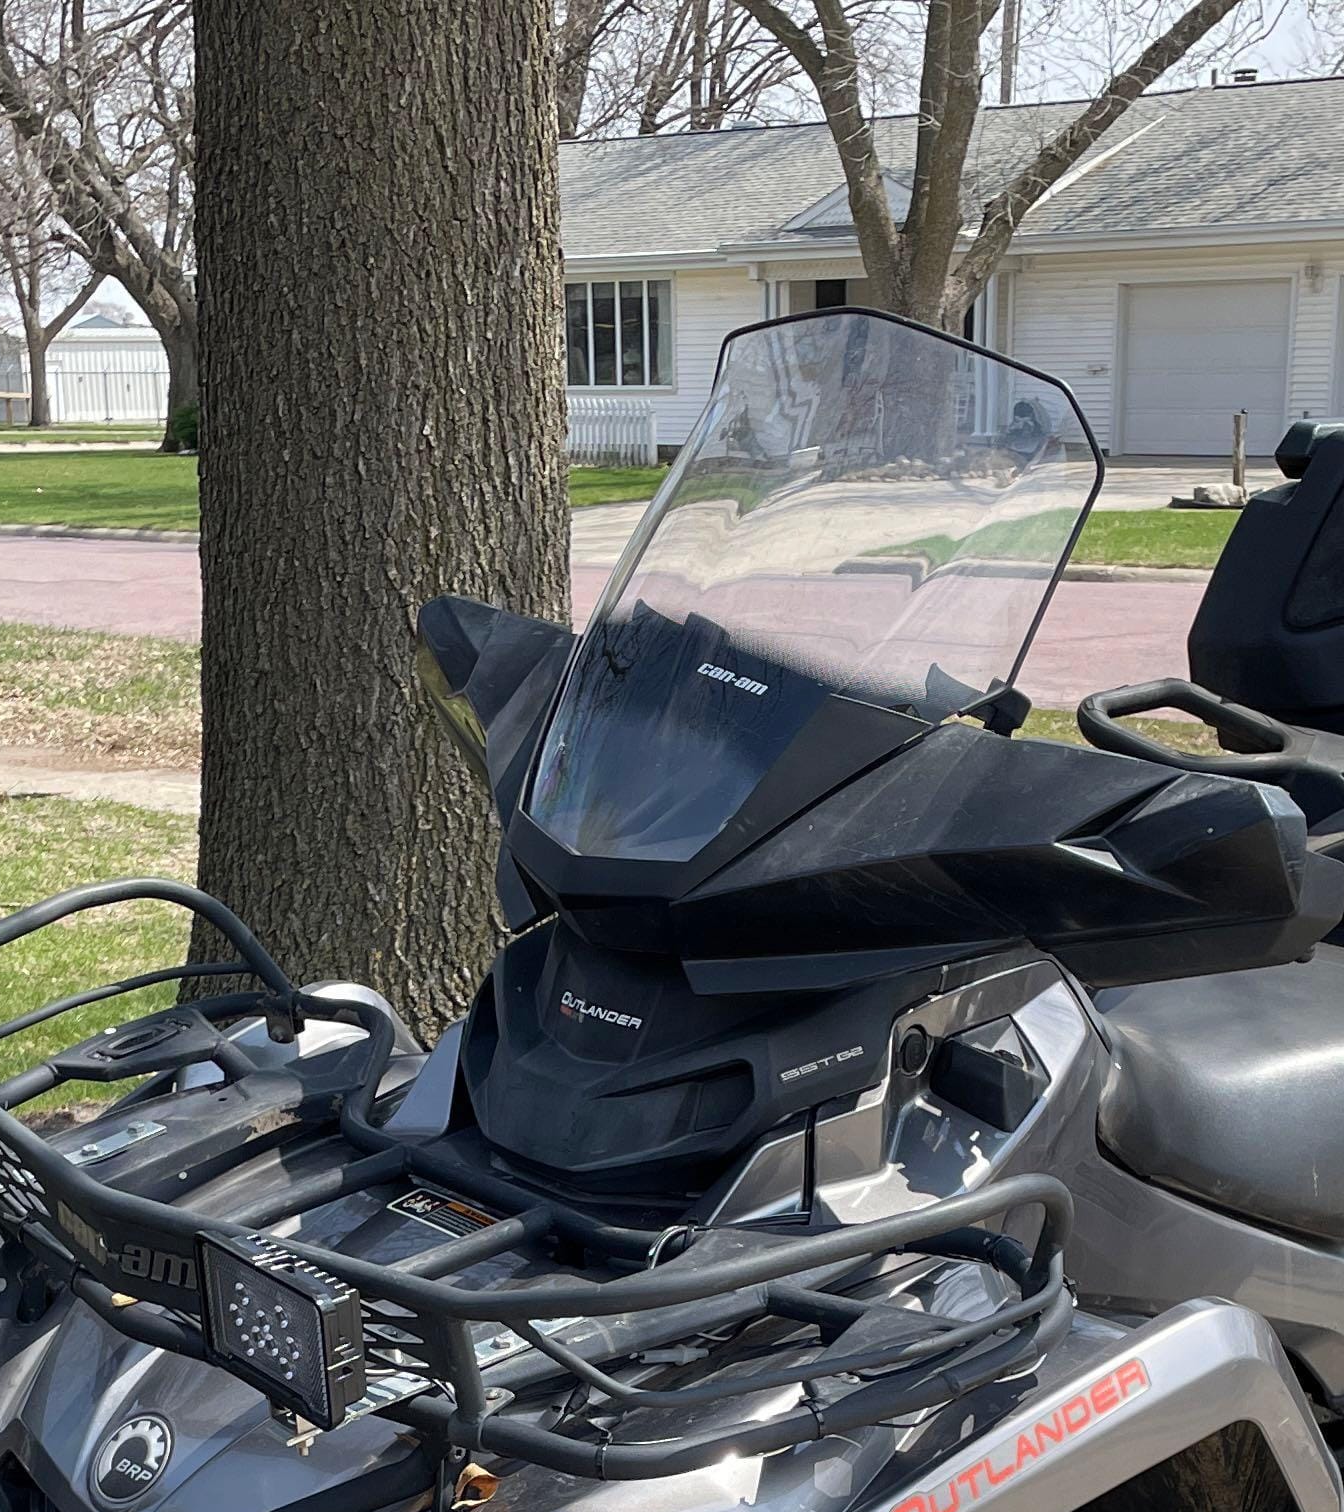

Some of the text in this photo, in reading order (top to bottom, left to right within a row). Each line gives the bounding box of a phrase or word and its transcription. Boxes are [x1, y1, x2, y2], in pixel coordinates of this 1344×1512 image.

[697, 662, 769, 696] can-am
[561, 991, 643, 1030] OUTLANDER
[116, 1458, 153, 1481] BRP
